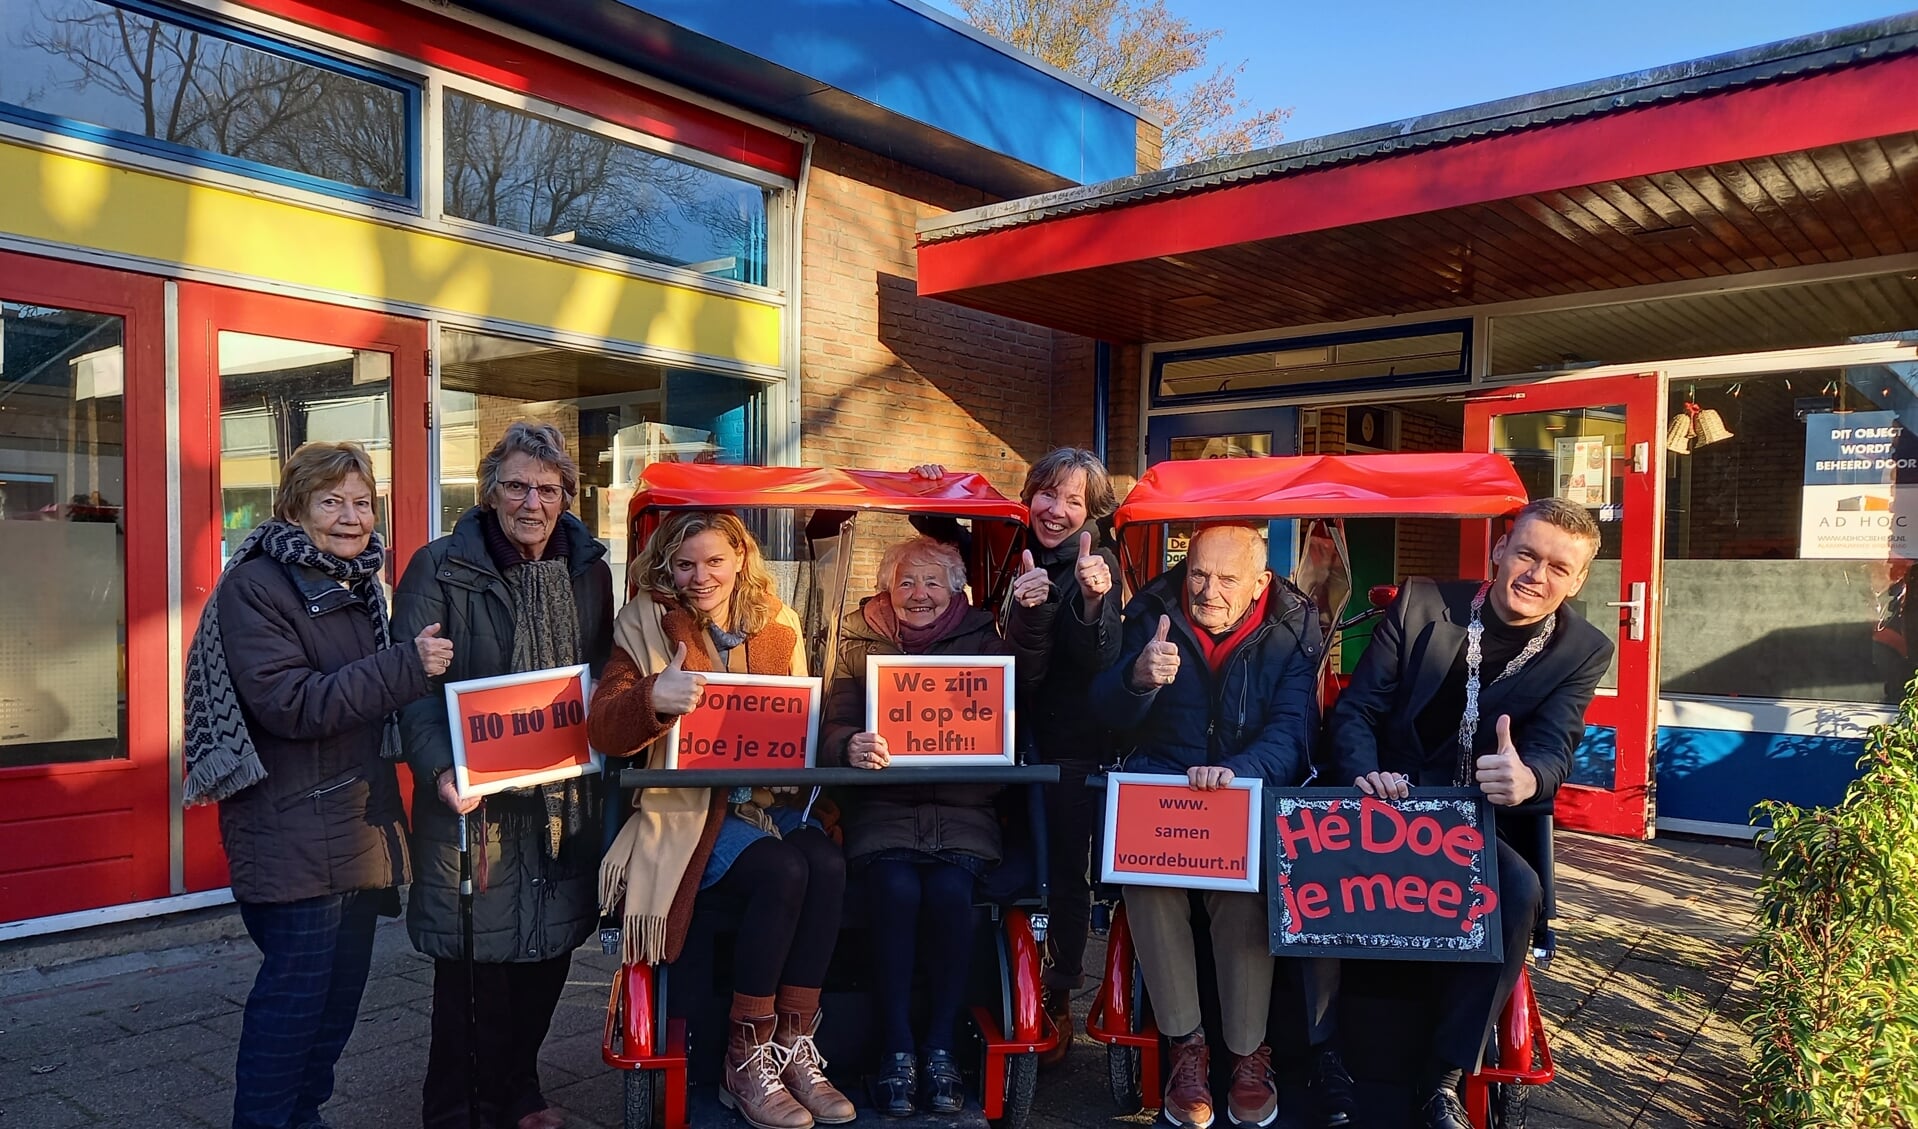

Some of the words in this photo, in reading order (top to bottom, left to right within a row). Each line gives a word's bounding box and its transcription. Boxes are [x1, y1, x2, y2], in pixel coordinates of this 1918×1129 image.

[1831, 429, 1852, 440] DIT
[1854, 427, 1903, 439] OBJECT
[1841, 443, 1892, 454] WORDT
[1815, 460, 1871, 471] BEHEERD
[1875, 459, 1916, 469] DOOR
[1819, 516, 1847, 527] AD
[1860, 516, 1907, 527] HOC
[1171, 539, 1187, 549] De
[893, 672, 936, 692] We
[944, 671, 988, 697] zijn
[468, 712, 504, 743] HO
[511, 708, 545, 736] HO
[551, 699, 584, 729] HO
[889, 701, 912, 722] al
[921, 708, 953, 728] op
[962, 700, 992, 721] de
[679, 732, 727, 756] doe
[733, 734, 759, 762] je
[906, 730, 975, 752] helft!!
[1159, 798, 1208, 811] www.
[1155, 826, 1210, 840] samen
[1276, 800, 1351, 860] Hé
[1360, 796, 1484, 867] Doe
[1118, 852, 1246, 871] voordebuurt.nl
[1278, 872, 1331, 934] je
[1340, 873, 1498, 933] mee?
